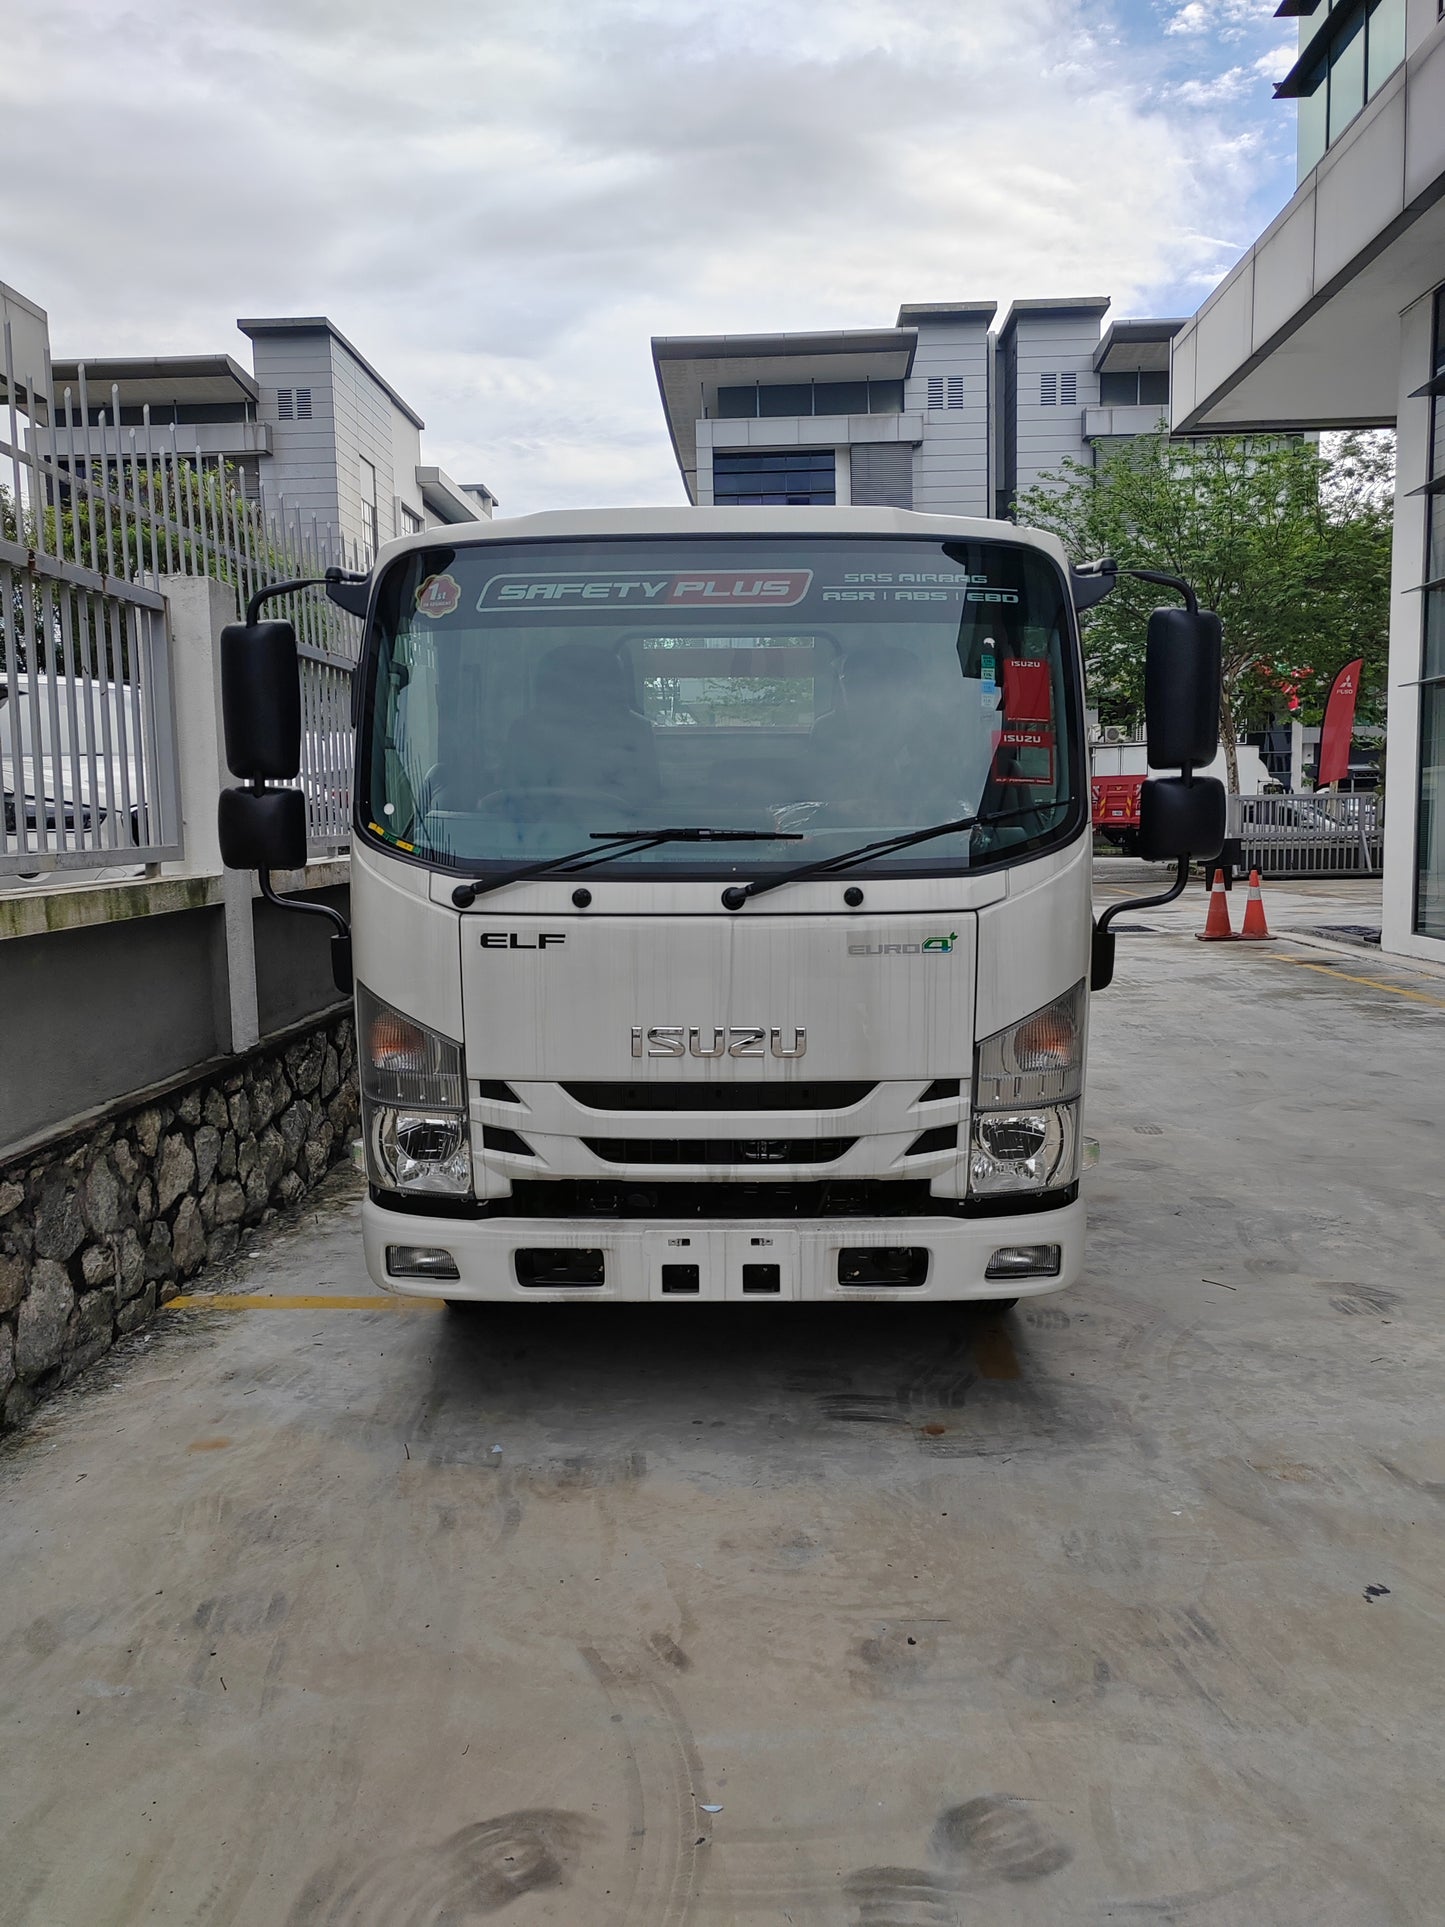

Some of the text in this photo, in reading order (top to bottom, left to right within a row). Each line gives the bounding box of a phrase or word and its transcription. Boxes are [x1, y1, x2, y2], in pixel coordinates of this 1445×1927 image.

[844, 573, 988, 585] SRS AIRBAG
[497, 580, 791, 600] SAFETY PLUS
[822, 591, 1019, 604] ASR ABS EBD
[1011, 660, 1041, 668] ISUZU
[1003, 734, 1042, 743] ISUZU
[480, 932, 566, 950] ELF
[631, 1026, 807, 1058] ISUZU
